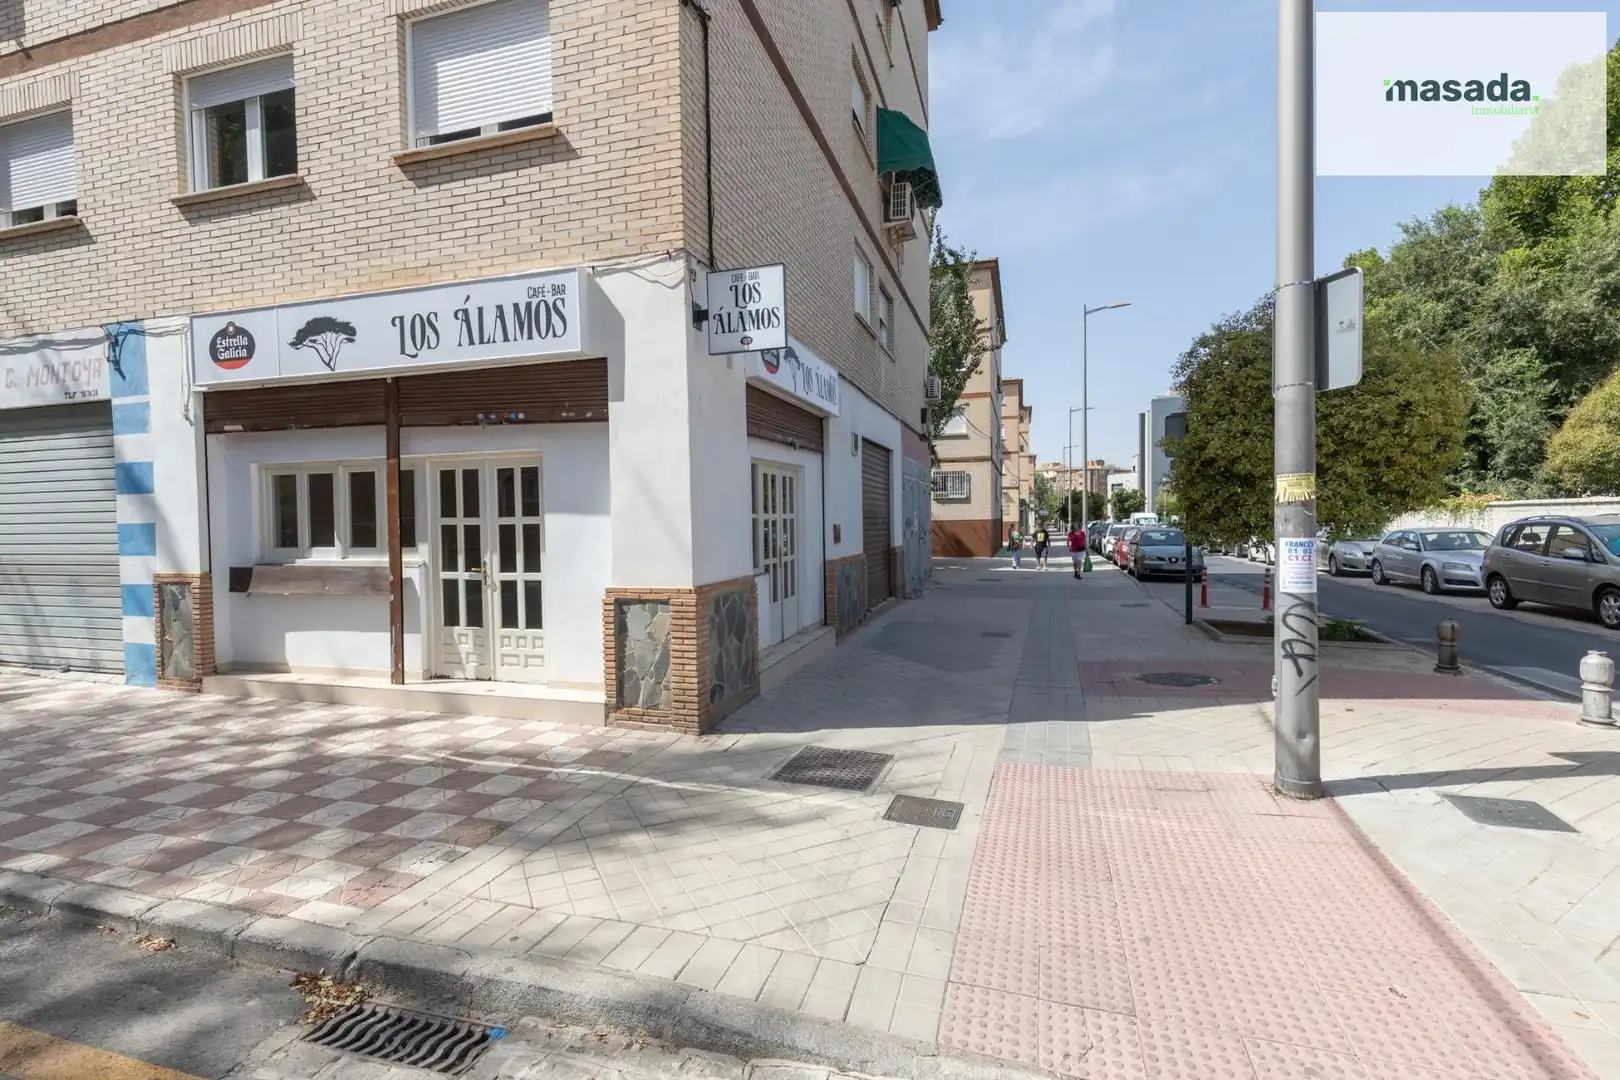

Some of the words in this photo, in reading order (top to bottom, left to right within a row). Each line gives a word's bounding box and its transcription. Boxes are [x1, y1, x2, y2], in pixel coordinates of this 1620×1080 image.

[729, 281, 762, 309] LOS
[390, 311, 440, 359] LOS
[453, 294, 568, 347] ÁLAMOS
[712, 306, 781, 335] ÁLAMOS
[216, 335, 249, 348] Estrella
[217, 346, 248, 360] Galicia
[26, 357, 103, 388] MONTOYA
